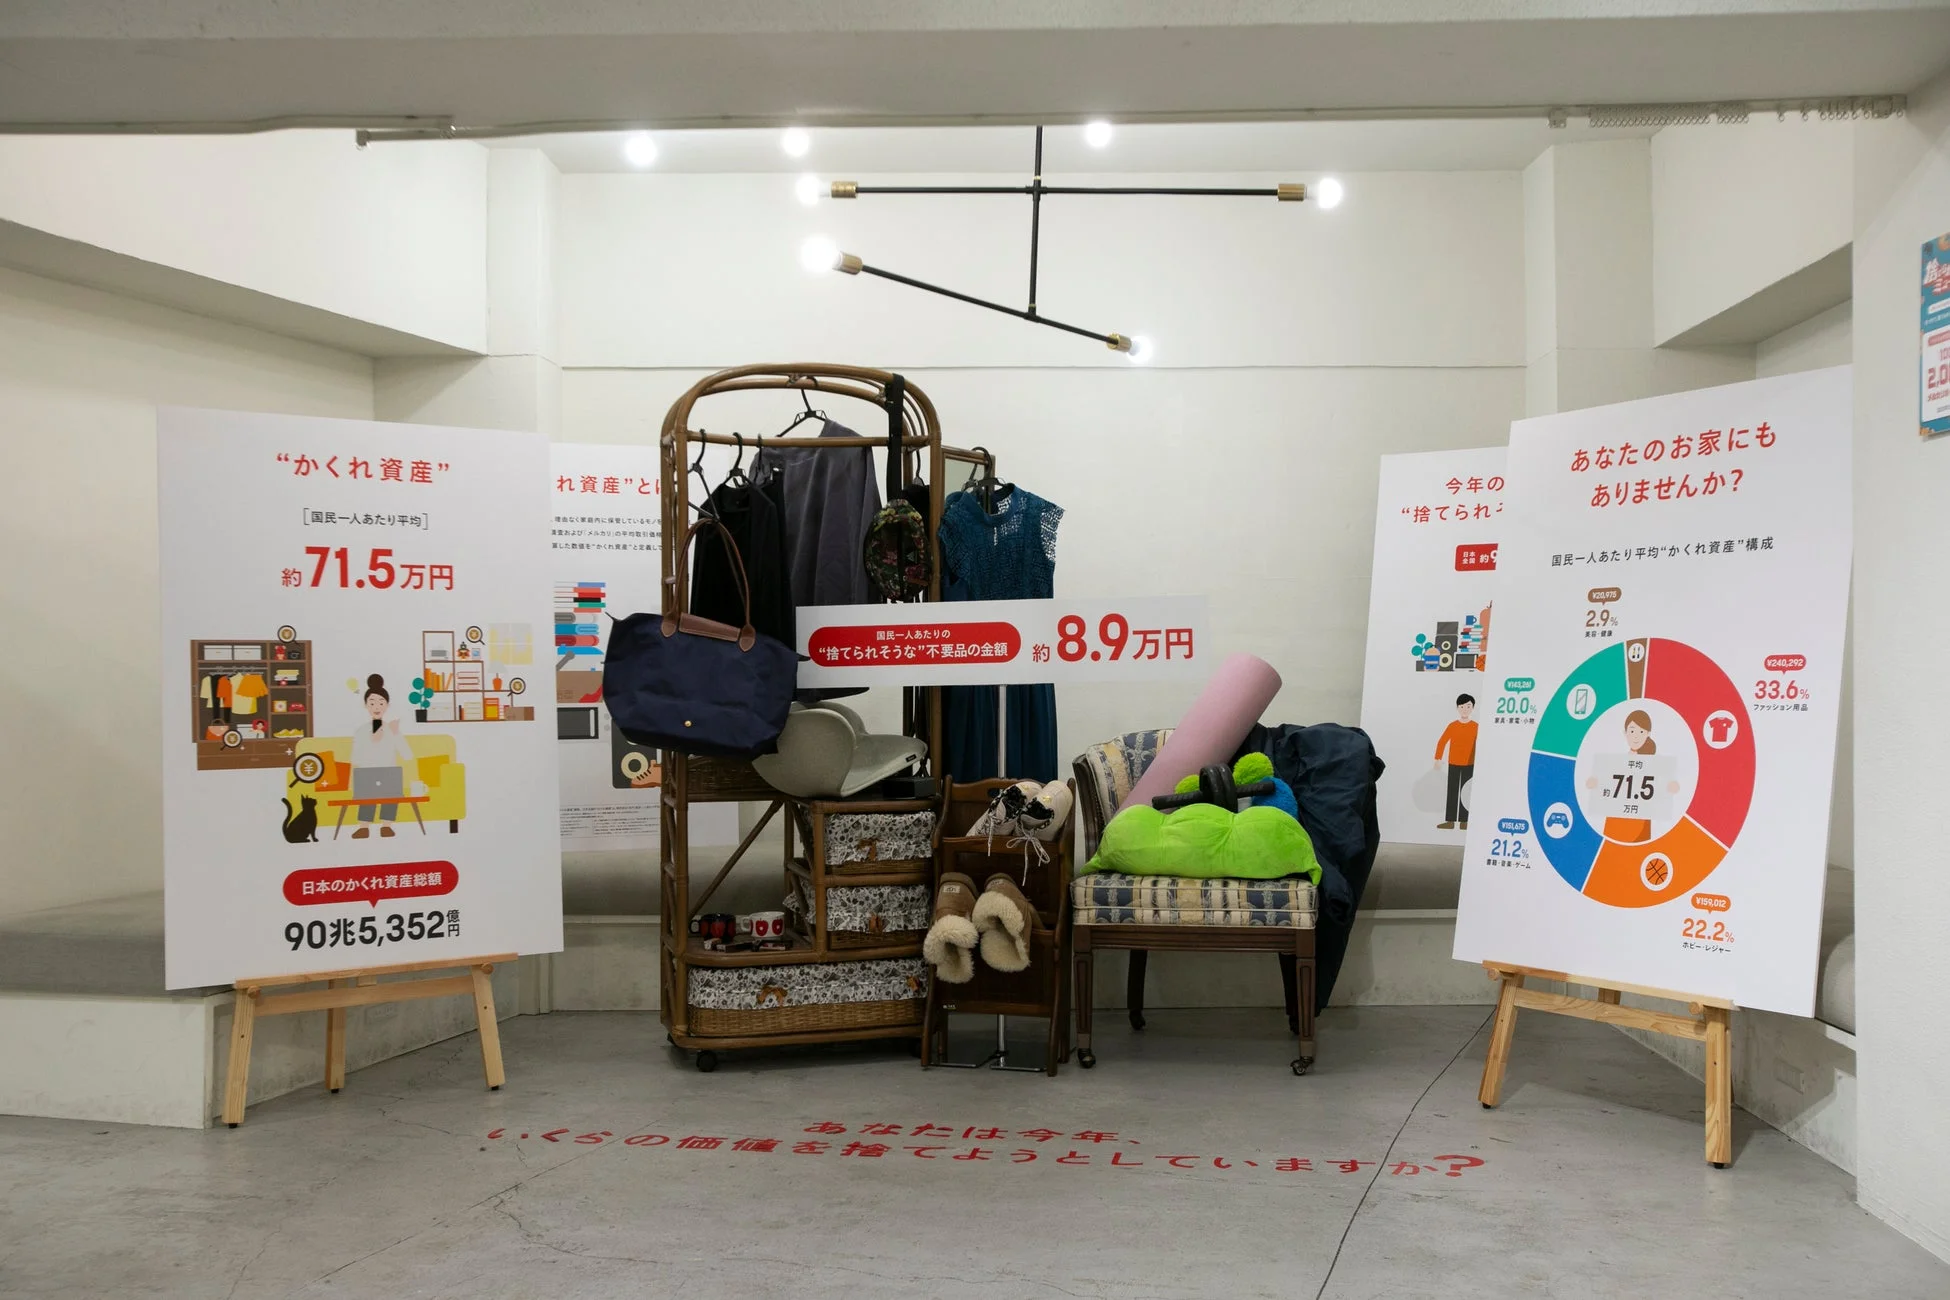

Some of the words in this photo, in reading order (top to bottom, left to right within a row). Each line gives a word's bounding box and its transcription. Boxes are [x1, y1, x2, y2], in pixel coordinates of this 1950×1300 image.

[1570, 421, 1777, 472] あなたのお家にも
[276, 453, 450, 484] “かくれ資産”
[1445, 476, 1505, 495] 今年の
[1590, 468, 1744, 508] ありませんか？
[281, 545, 454, 591] 約71.5万円
[1586, 609, 1619, 627] 2.9%
[876, 629, 951, 641] 国民一人あたりの
[1032, 612, 1194, 664] 約8.9万円
[818, 641, 1009, 661] “捨てられそうな”不要品の金額
[1755, 679, 1810, 700] 33.6%
[1496, 697, 1538, 714] 20.0%
[1753, 703, 1809, 712] ファッション用品
[1627, 760, 1643, 769] 平均
[1603, 774, 1655, 800] 約71.5
[1623, 804, 1639, 814] 万円
[1491, 838, 1530, 859] 21.2%
[301, 870, 442, 896] 日本のかくれ資産総額
[1682, 917, 1735, 943] 22.2%
[487, 1127, 1486, 1178] いくらの価値を捨てようとしていますか？
